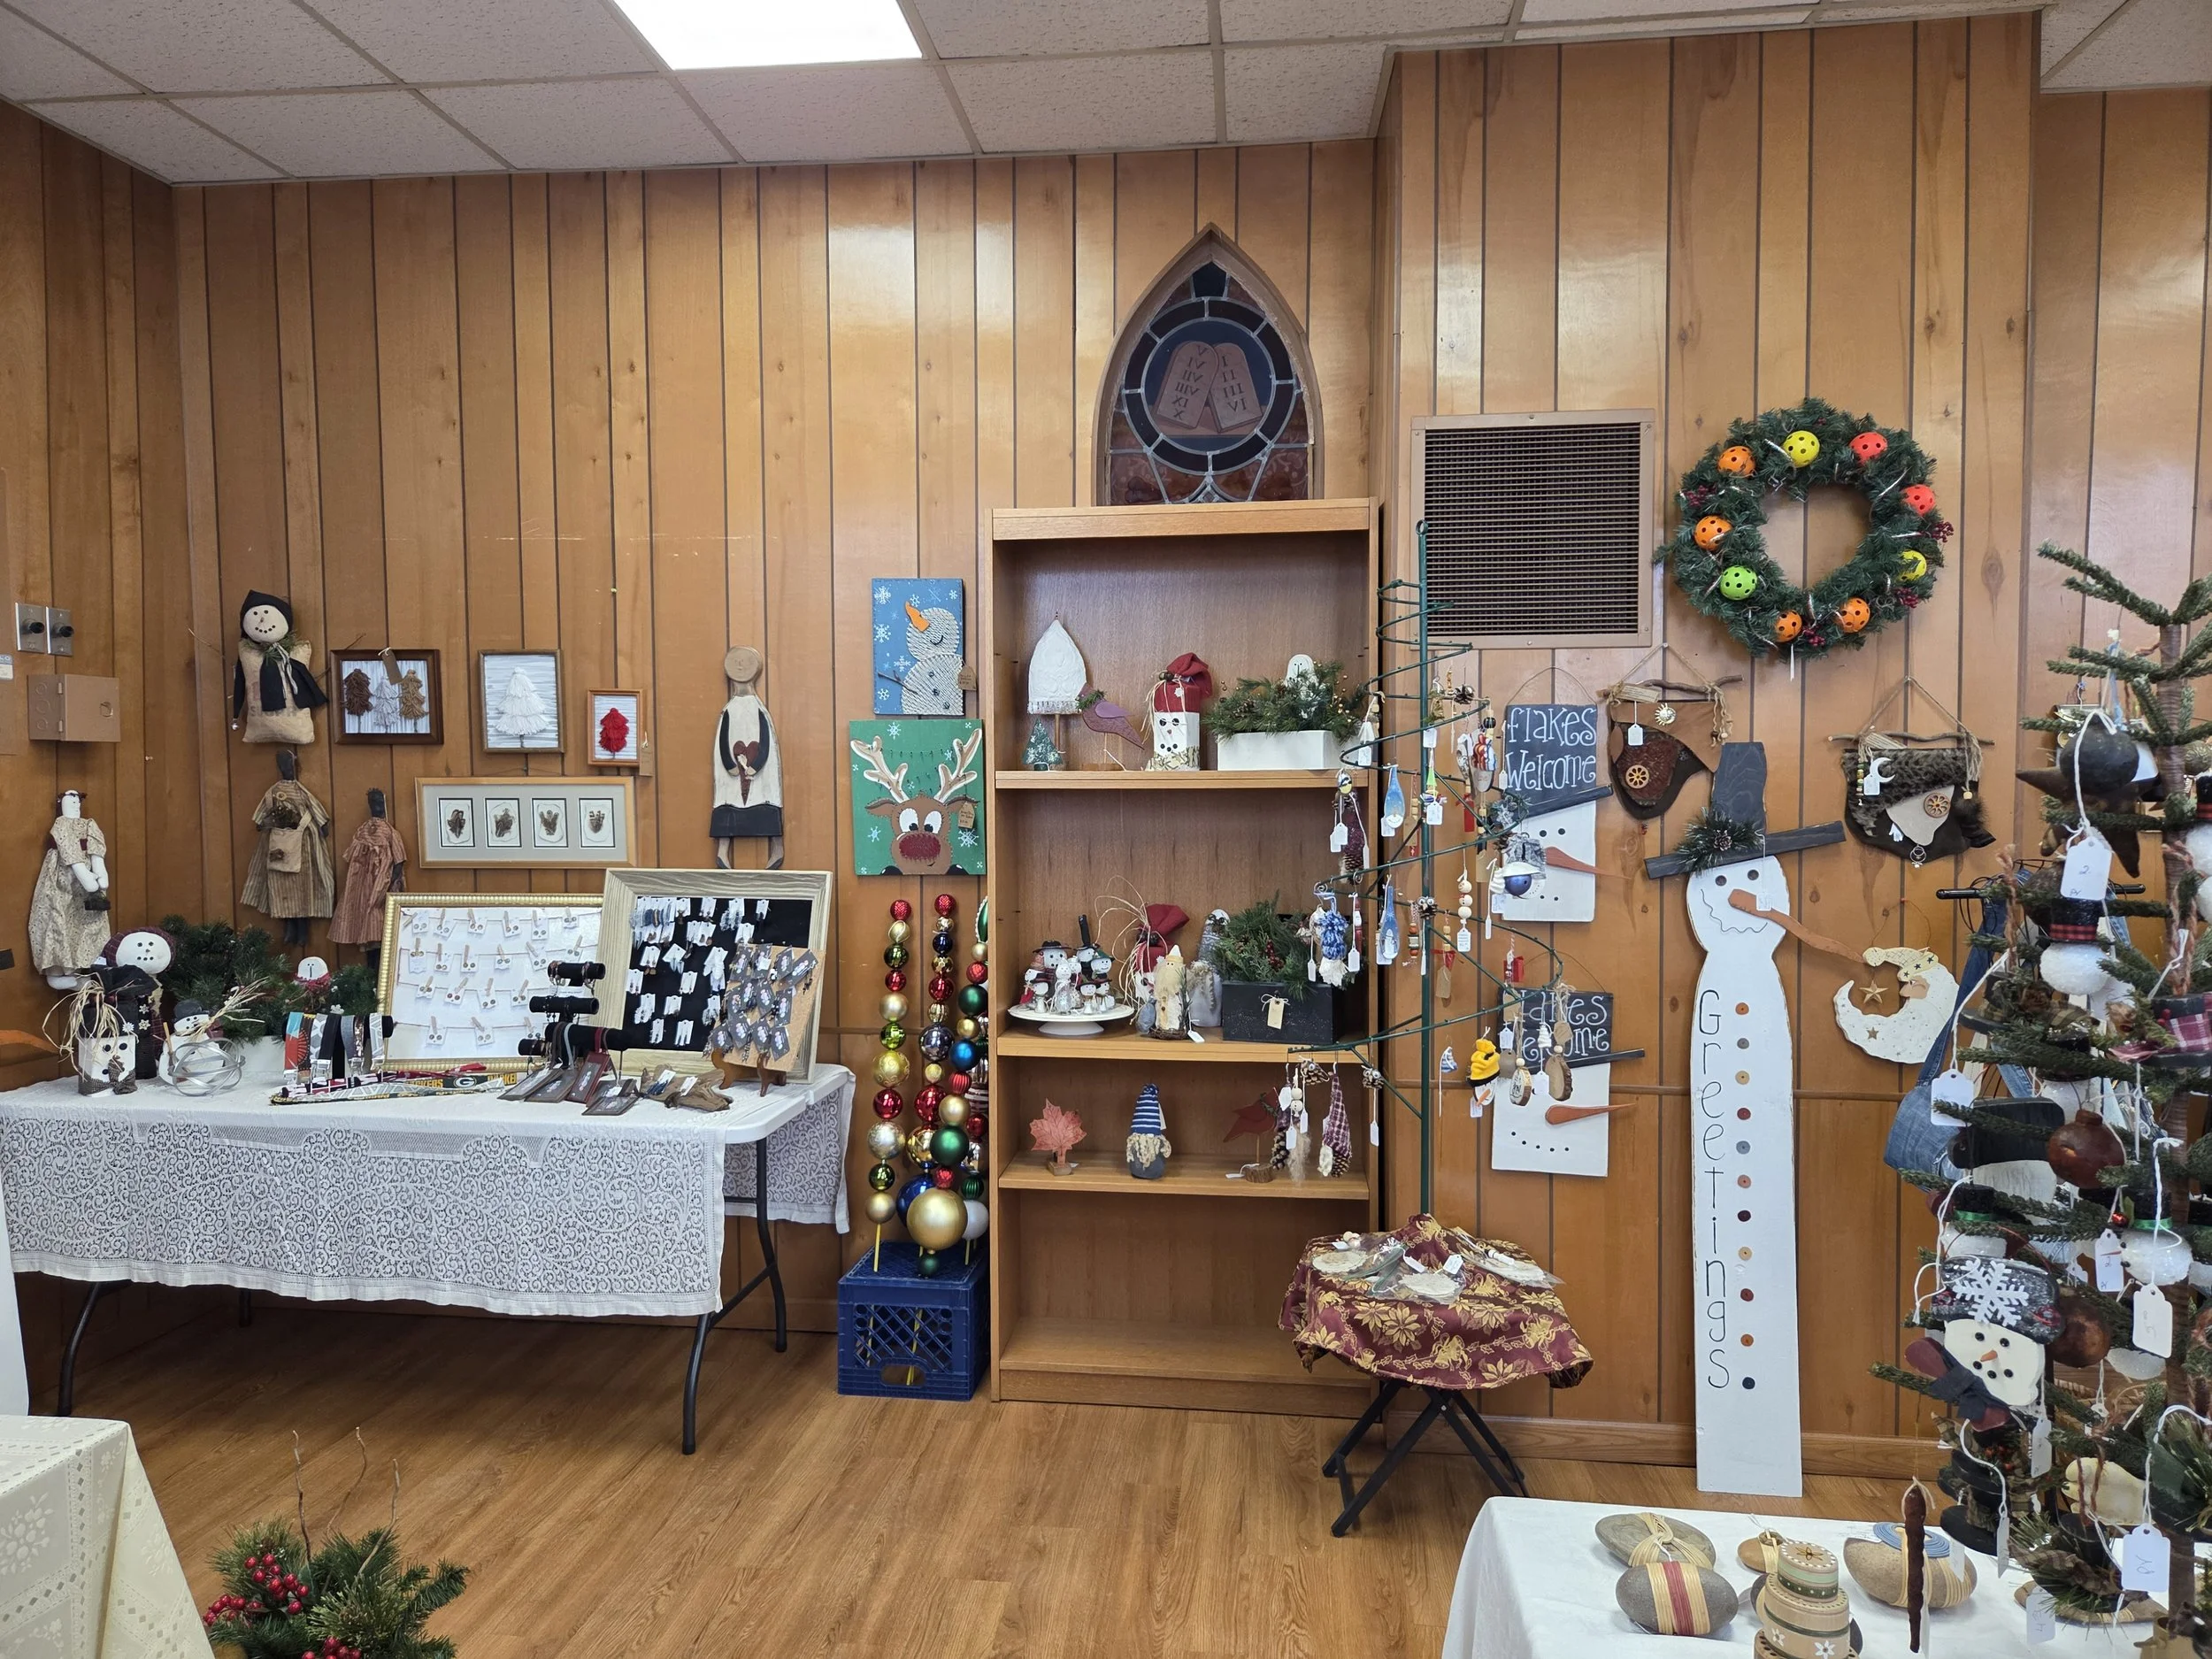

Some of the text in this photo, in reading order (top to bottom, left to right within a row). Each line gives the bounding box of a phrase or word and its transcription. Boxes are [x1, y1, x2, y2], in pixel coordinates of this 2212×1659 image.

[1507, 707, 1597, 747] flakes
[1505, 749, 1597, 792] Welcome
[1504, 989, 1608, 1026] laes
[1698, 989, 1731, 1390] Greetings
